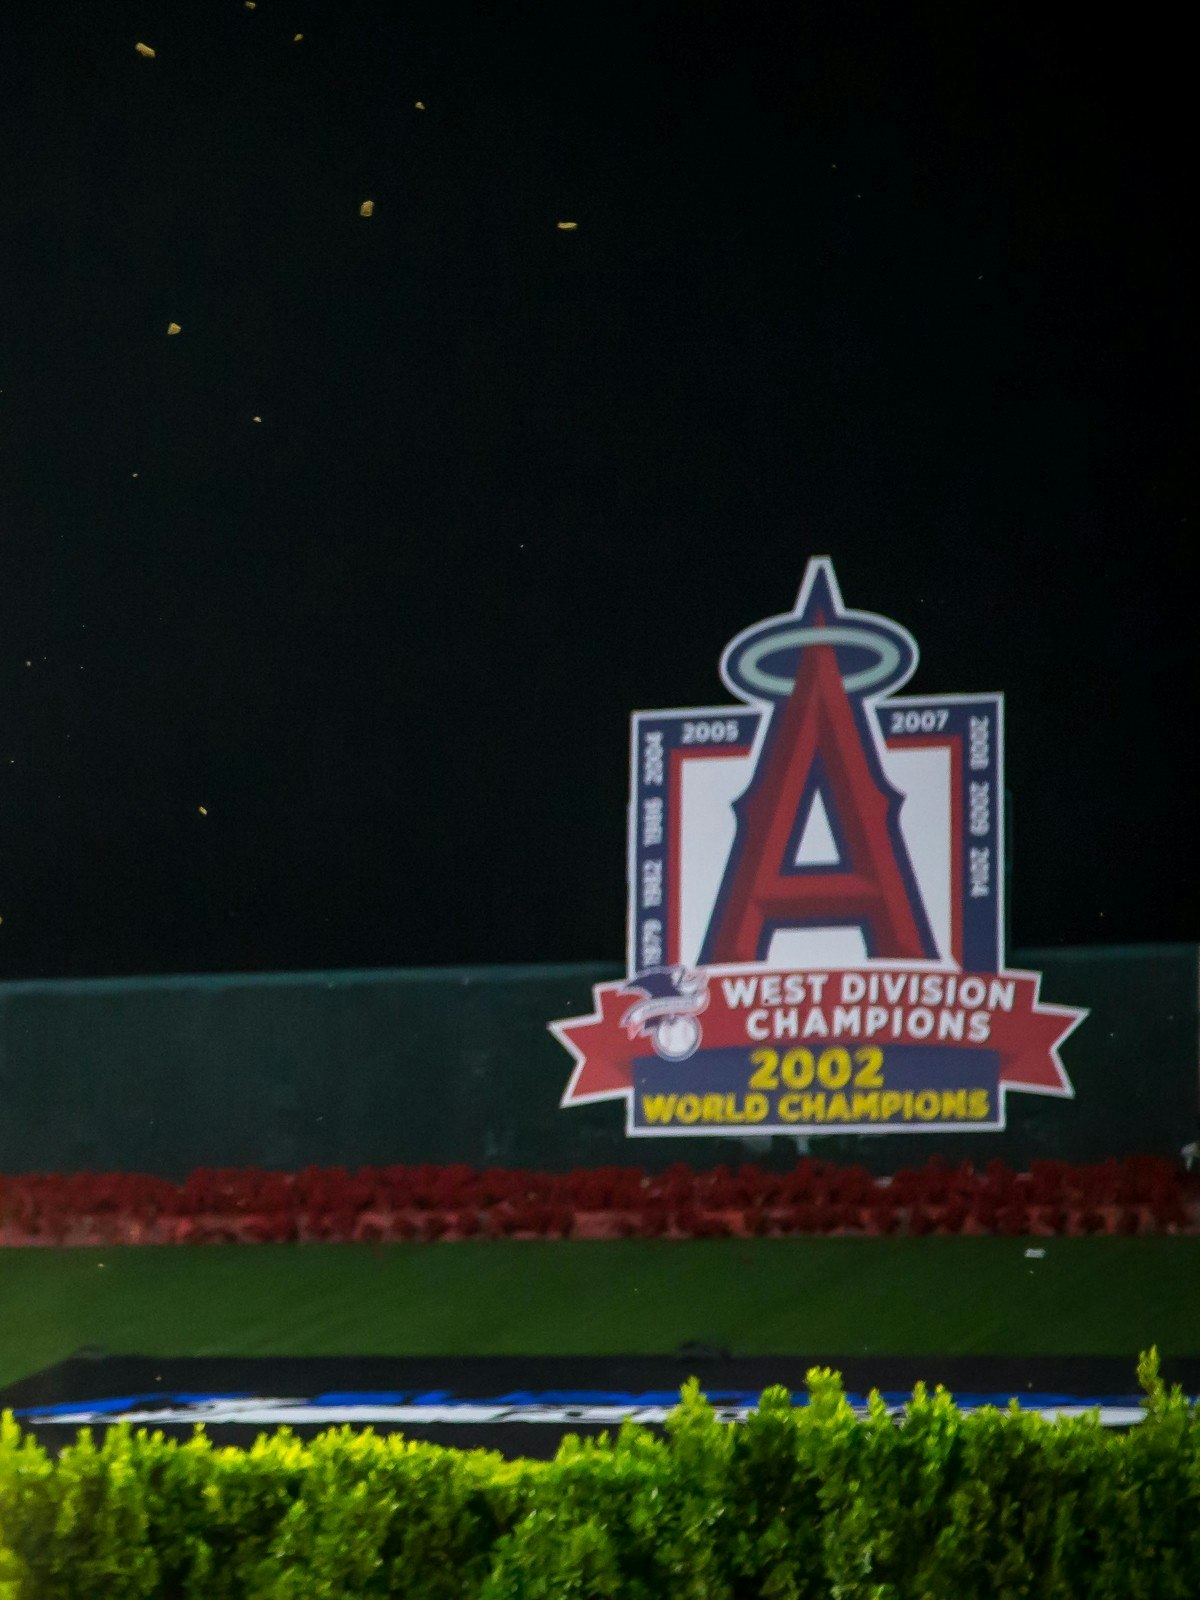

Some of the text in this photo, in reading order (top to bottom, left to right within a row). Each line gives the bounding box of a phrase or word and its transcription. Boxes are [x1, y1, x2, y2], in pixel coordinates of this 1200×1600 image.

[681, 720, 739, 744] 2005
[890, 709, 949, 734] 2007
[643, 731, 664, 785] 2004
[968, 715, 990, 898] 2008 2009 2014
[642, 859, 663, 909] 1982
[641, 918, 662, 966] 1979
[721, 974, 829, 1009] WEST
[840, 973, 1015, 1013] DIVISION
[745, 1006, 992, 1043] CHAMPIONS
[748, 1045, 885, 1092] 2002
[641, 1088, 990, 1125] WORLD CHAMPIONS
